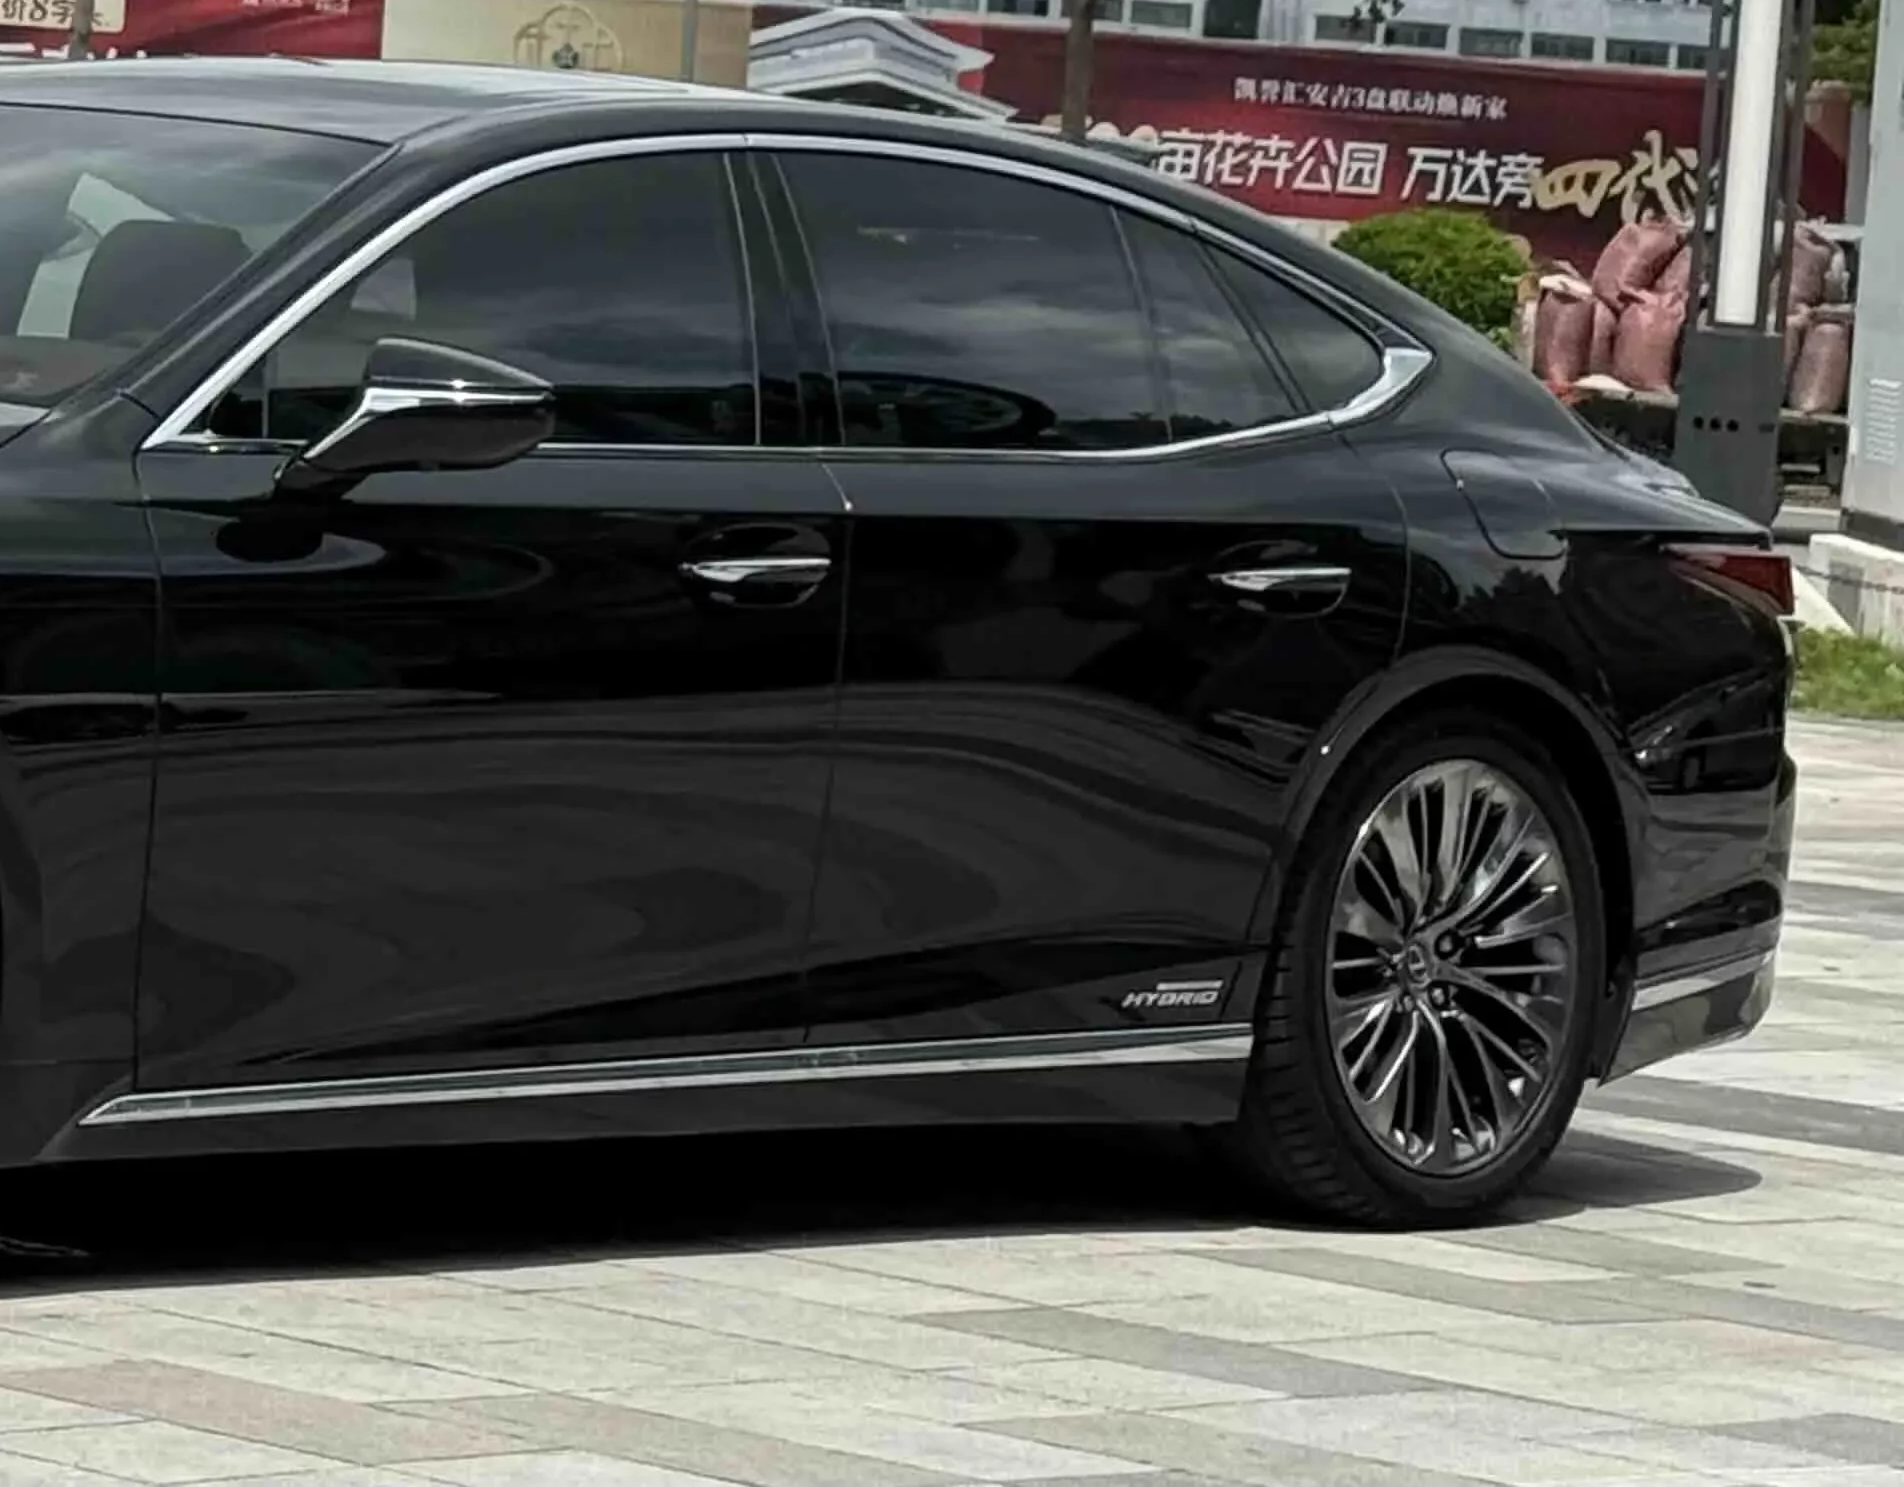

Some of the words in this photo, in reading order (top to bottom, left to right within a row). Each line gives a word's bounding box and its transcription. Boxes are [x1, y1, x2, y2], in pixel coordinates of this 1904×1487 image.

[1400, 146, 1544, 209] 万达旁
[1122, 991, 1218, 1008] HYBRID
